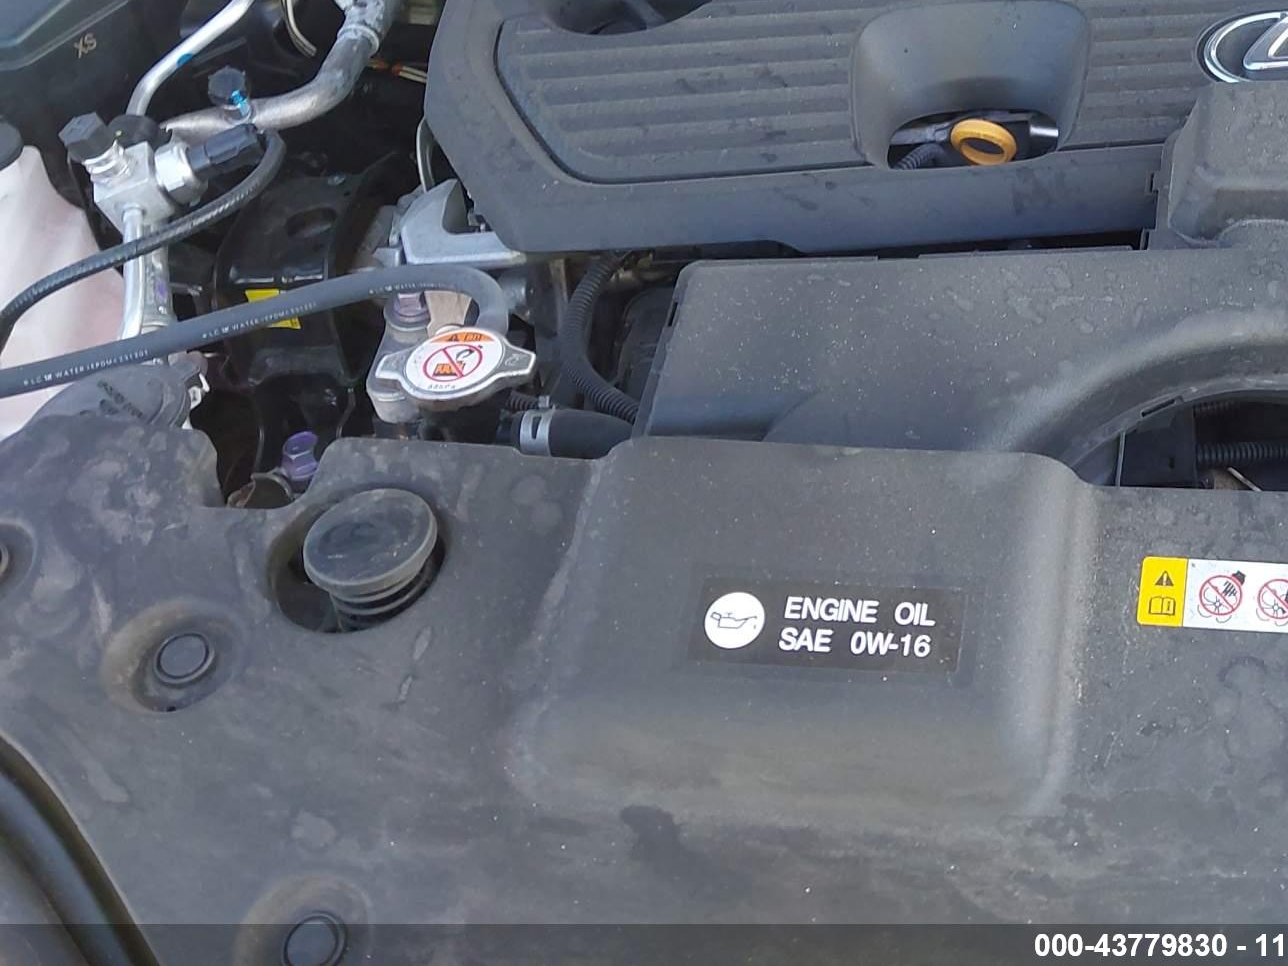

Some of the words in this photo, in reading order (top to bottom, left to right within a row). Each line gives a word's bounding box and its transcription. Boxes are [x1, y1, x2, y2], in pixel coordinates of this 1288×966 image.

[55, 364, 85, 379] WATER
[784, 596, 880, 624] ENGINE
[893, 601, 937, 627] OIL
[778, 627, 834, 653] SAE
[850, 630, 932, 658] 0W-16
